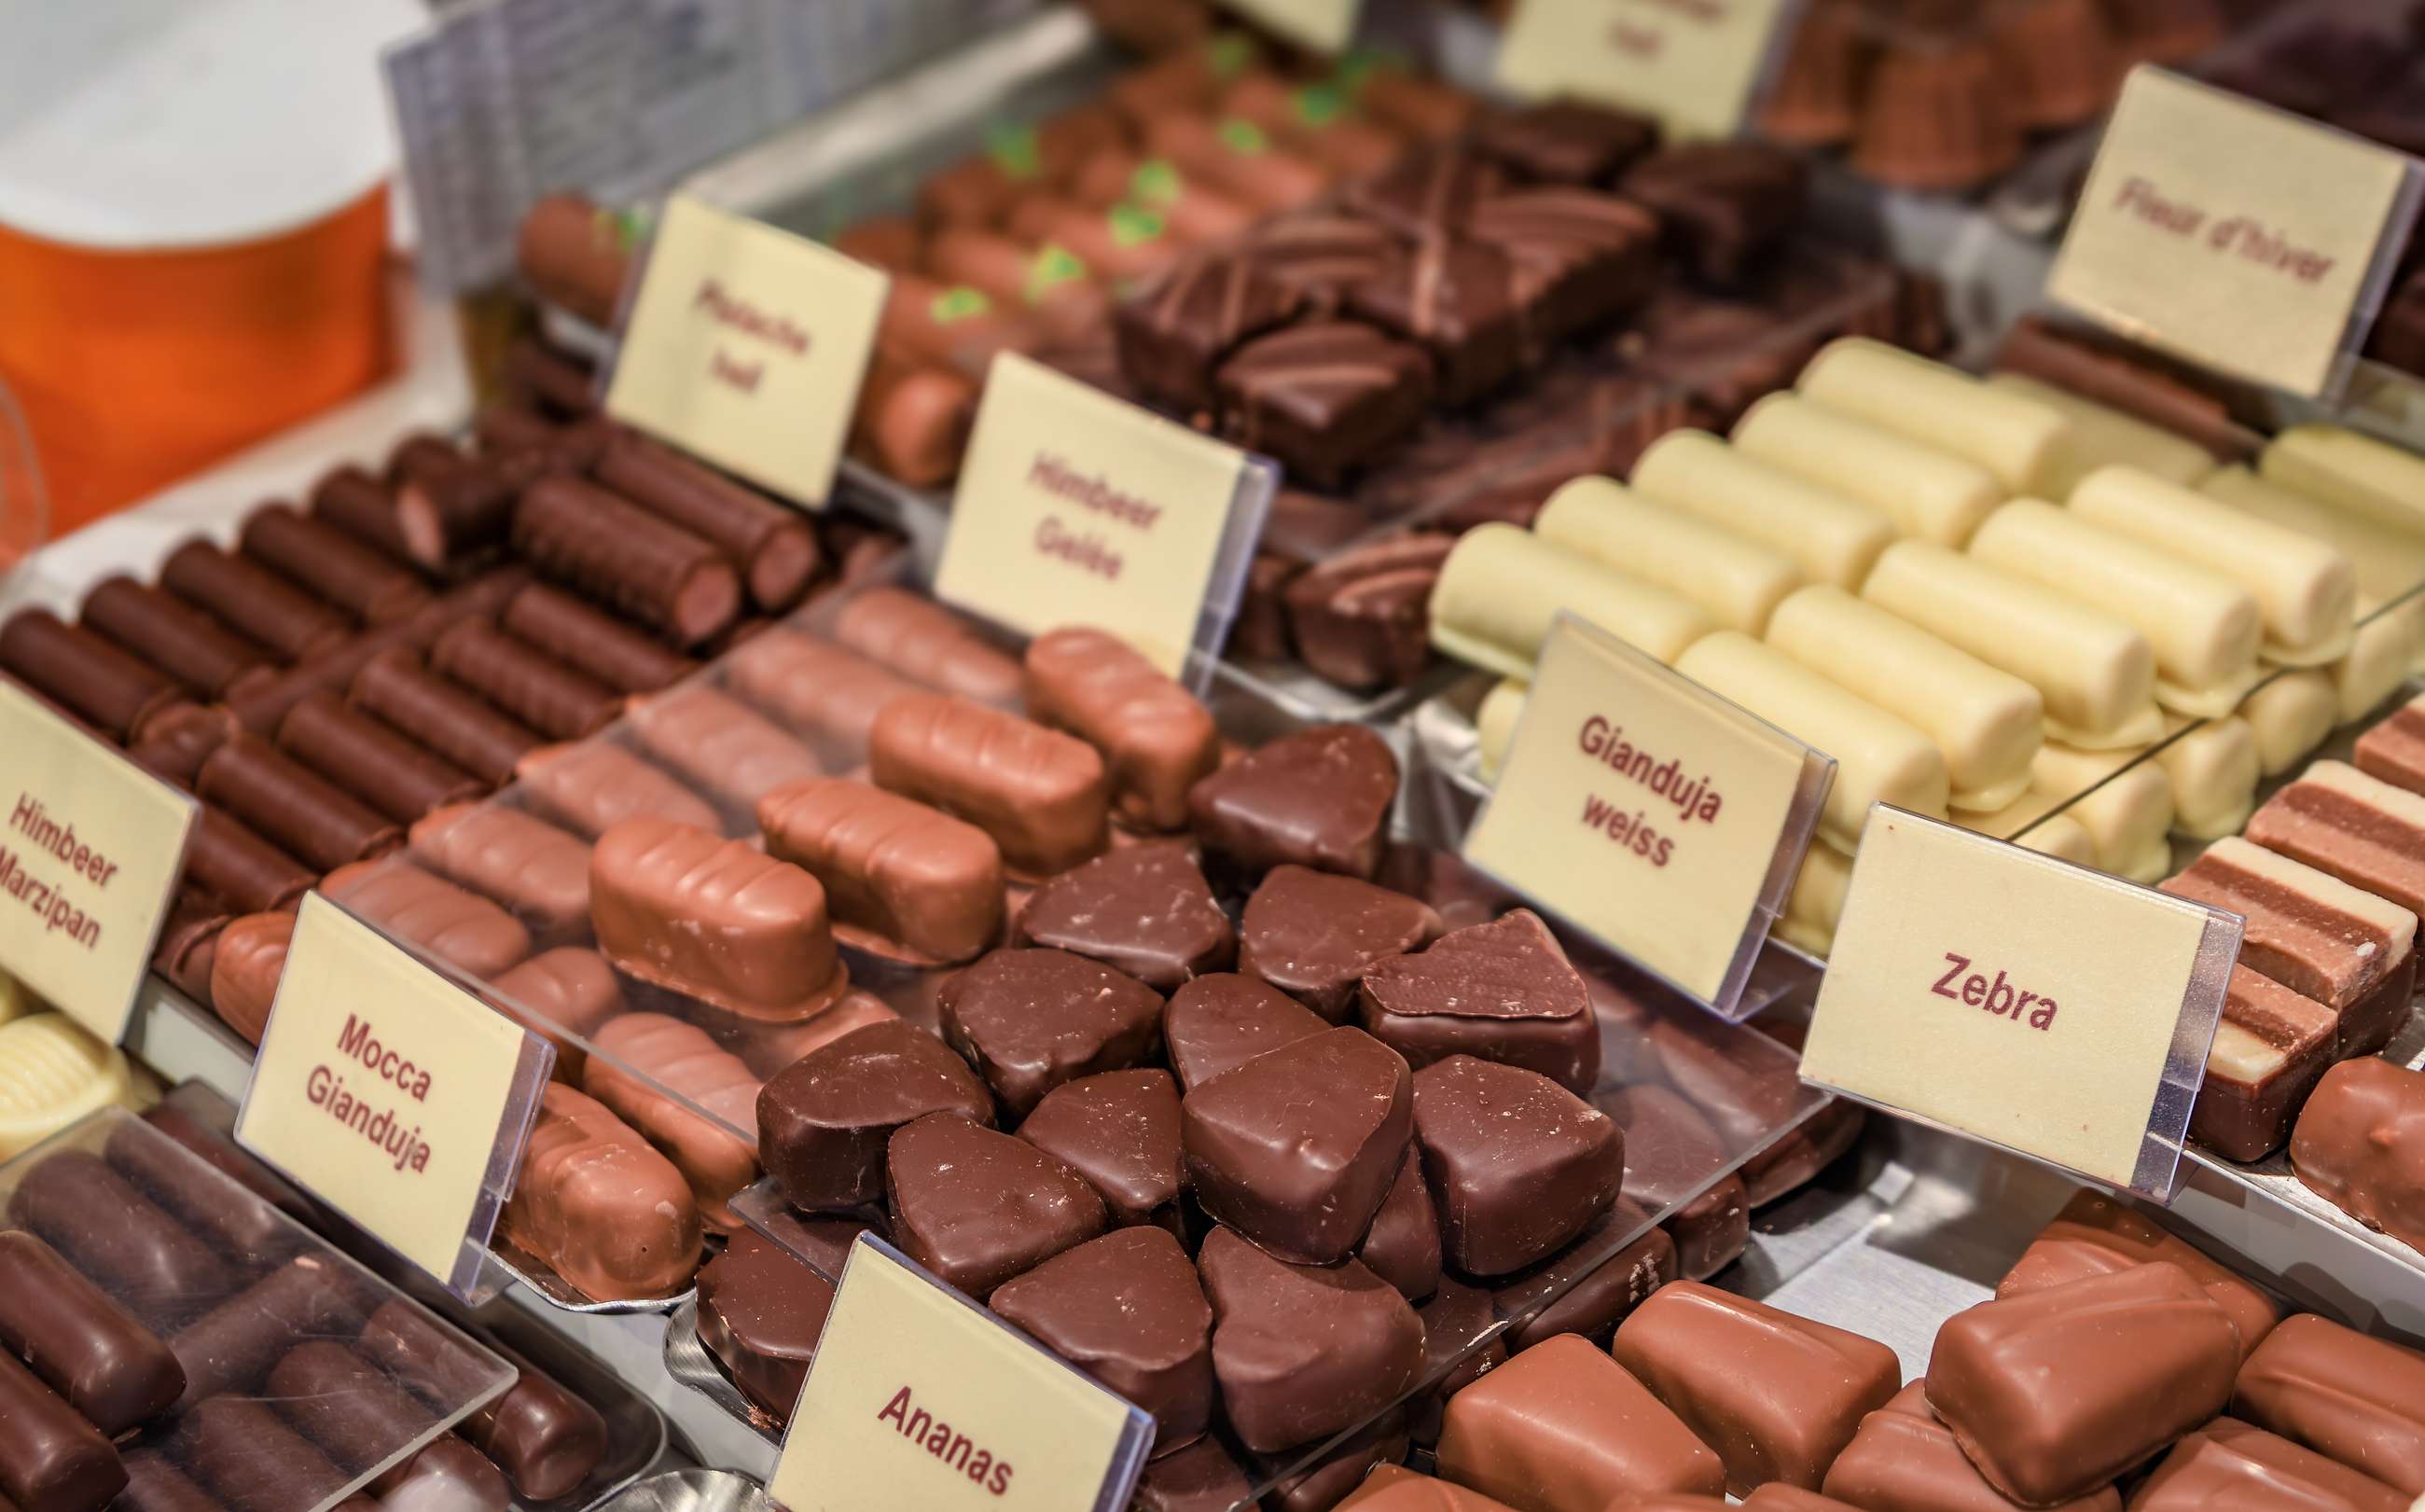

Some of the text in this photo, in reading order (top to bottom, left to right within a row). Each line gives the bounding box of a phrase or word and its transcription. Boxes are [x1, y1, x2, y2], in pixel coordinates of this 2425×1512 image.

[1029, 451, 1164, 530] Himbeer
[1578, 714, 1724, 823] Gianduja
[8, 791, 118, 887] Himbeer
[1582, 794, 1675, 868] weiss
[1931, 951, 2059, 1032] Zebra
[336, 1013, 433, 1103] Mocca
[305, 1064, 432, 1173] Gianduja
[877, 1385, 1015, 1496] Ananas
